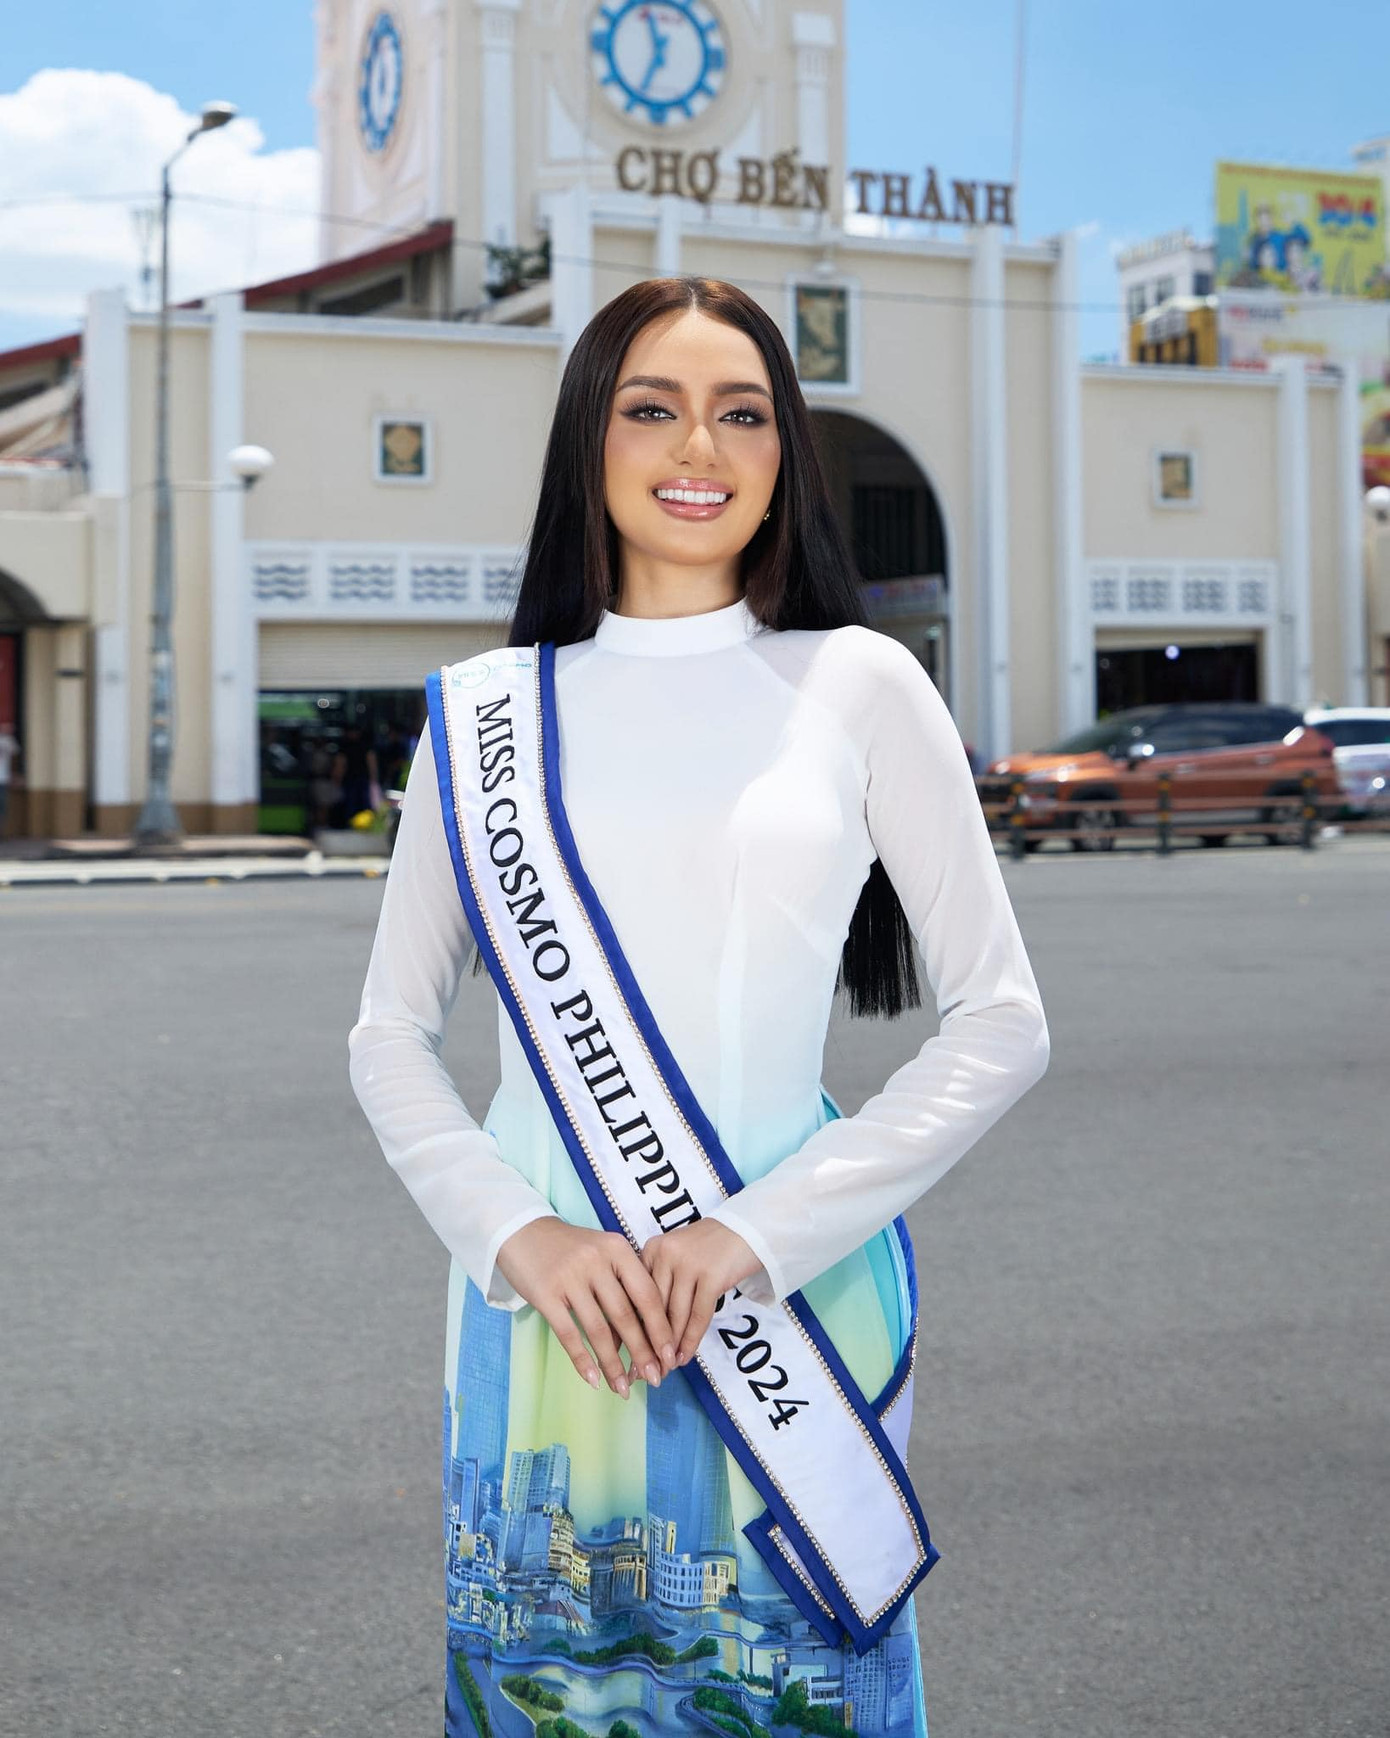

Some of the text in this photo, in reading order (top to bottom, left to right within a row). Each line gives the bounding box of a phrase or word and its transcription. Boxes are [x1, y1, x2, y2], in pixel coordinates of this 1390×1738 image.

[616, 144, 1015, 226] CHỢ BẾN THÀNH
[475, 693, 516, 794] MISS
[484, 797, 571, 983] COSMO
[550, 988, 742, 1313] PHILIPPI
[716, 1314, 810, 1431] 2024
